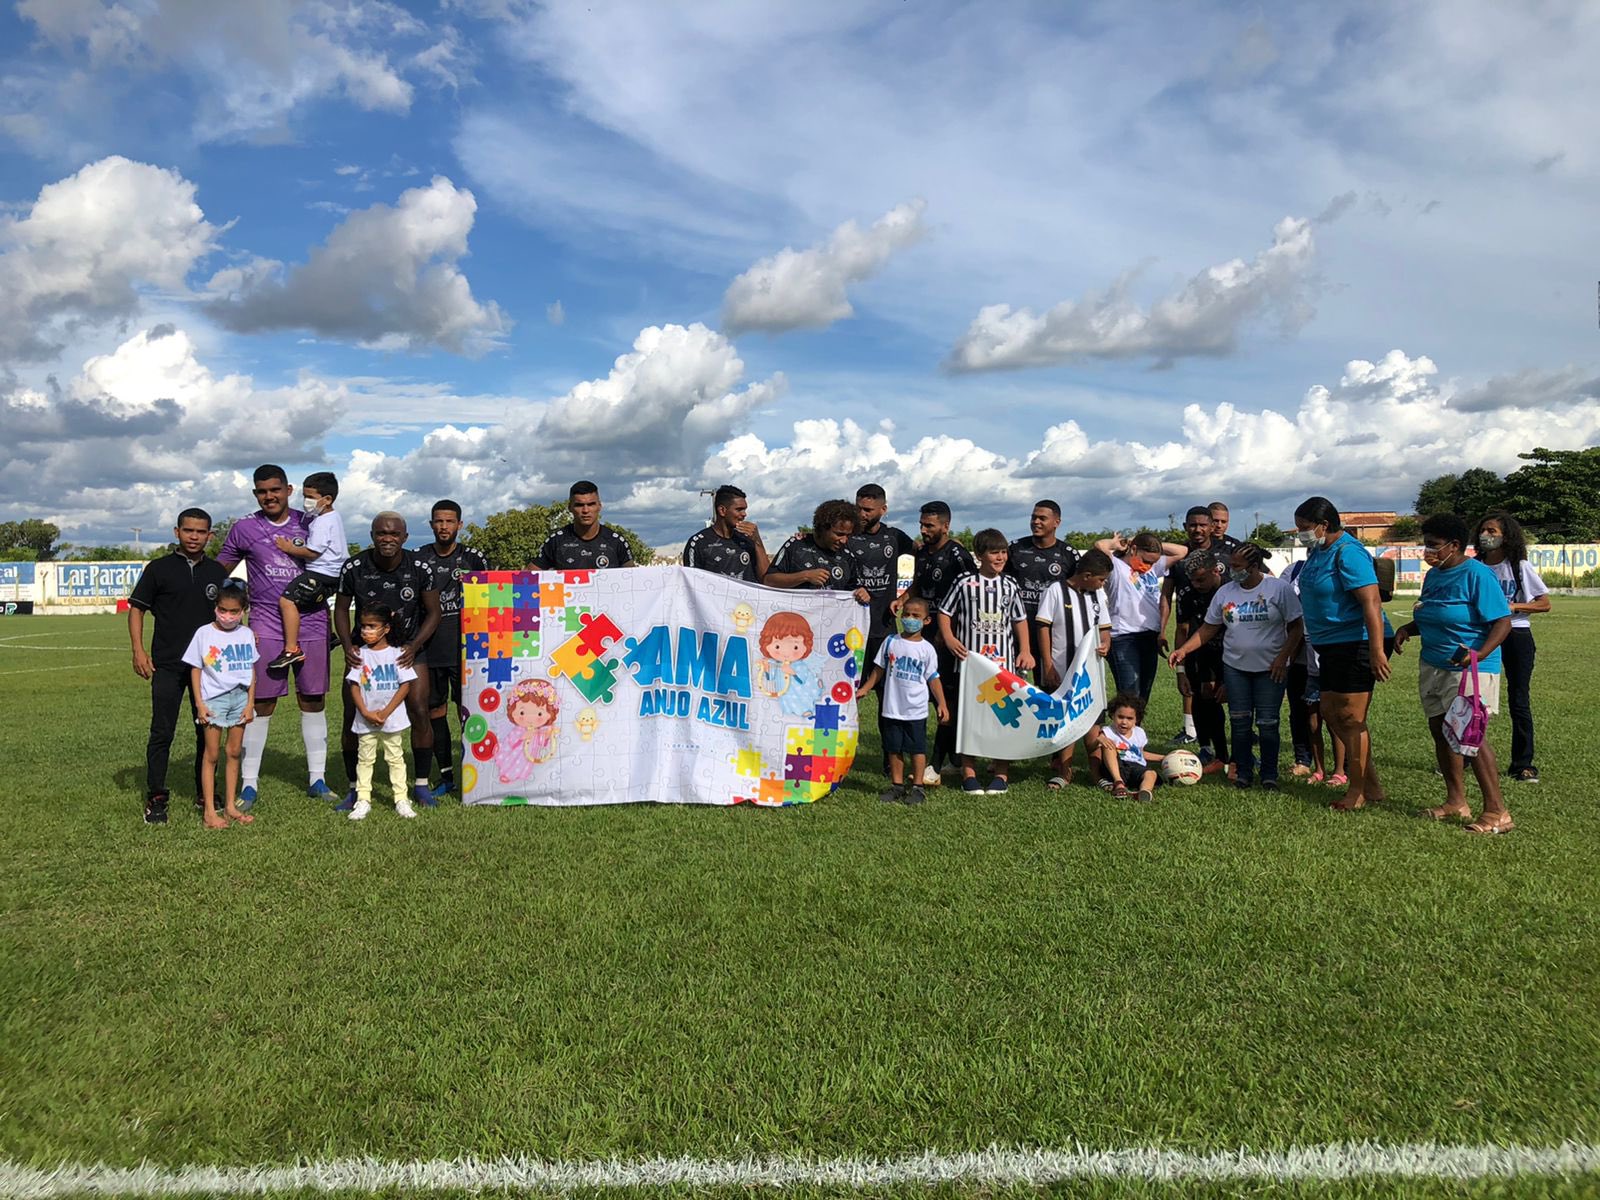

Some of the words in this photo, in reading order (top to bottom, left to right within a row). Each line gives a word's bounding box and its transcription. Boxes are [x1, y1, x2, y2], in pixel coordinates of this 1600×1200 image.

[1528, 549, 1598, 567] ORADO
[228, 662, 243, 671] ANJO
[621, 624, 753, 699] AMA
[639, 688, 692, 719] ANJO
[696, 695, 751, 732] AZUL
[1066, 690, 1094, 722] AZUL
